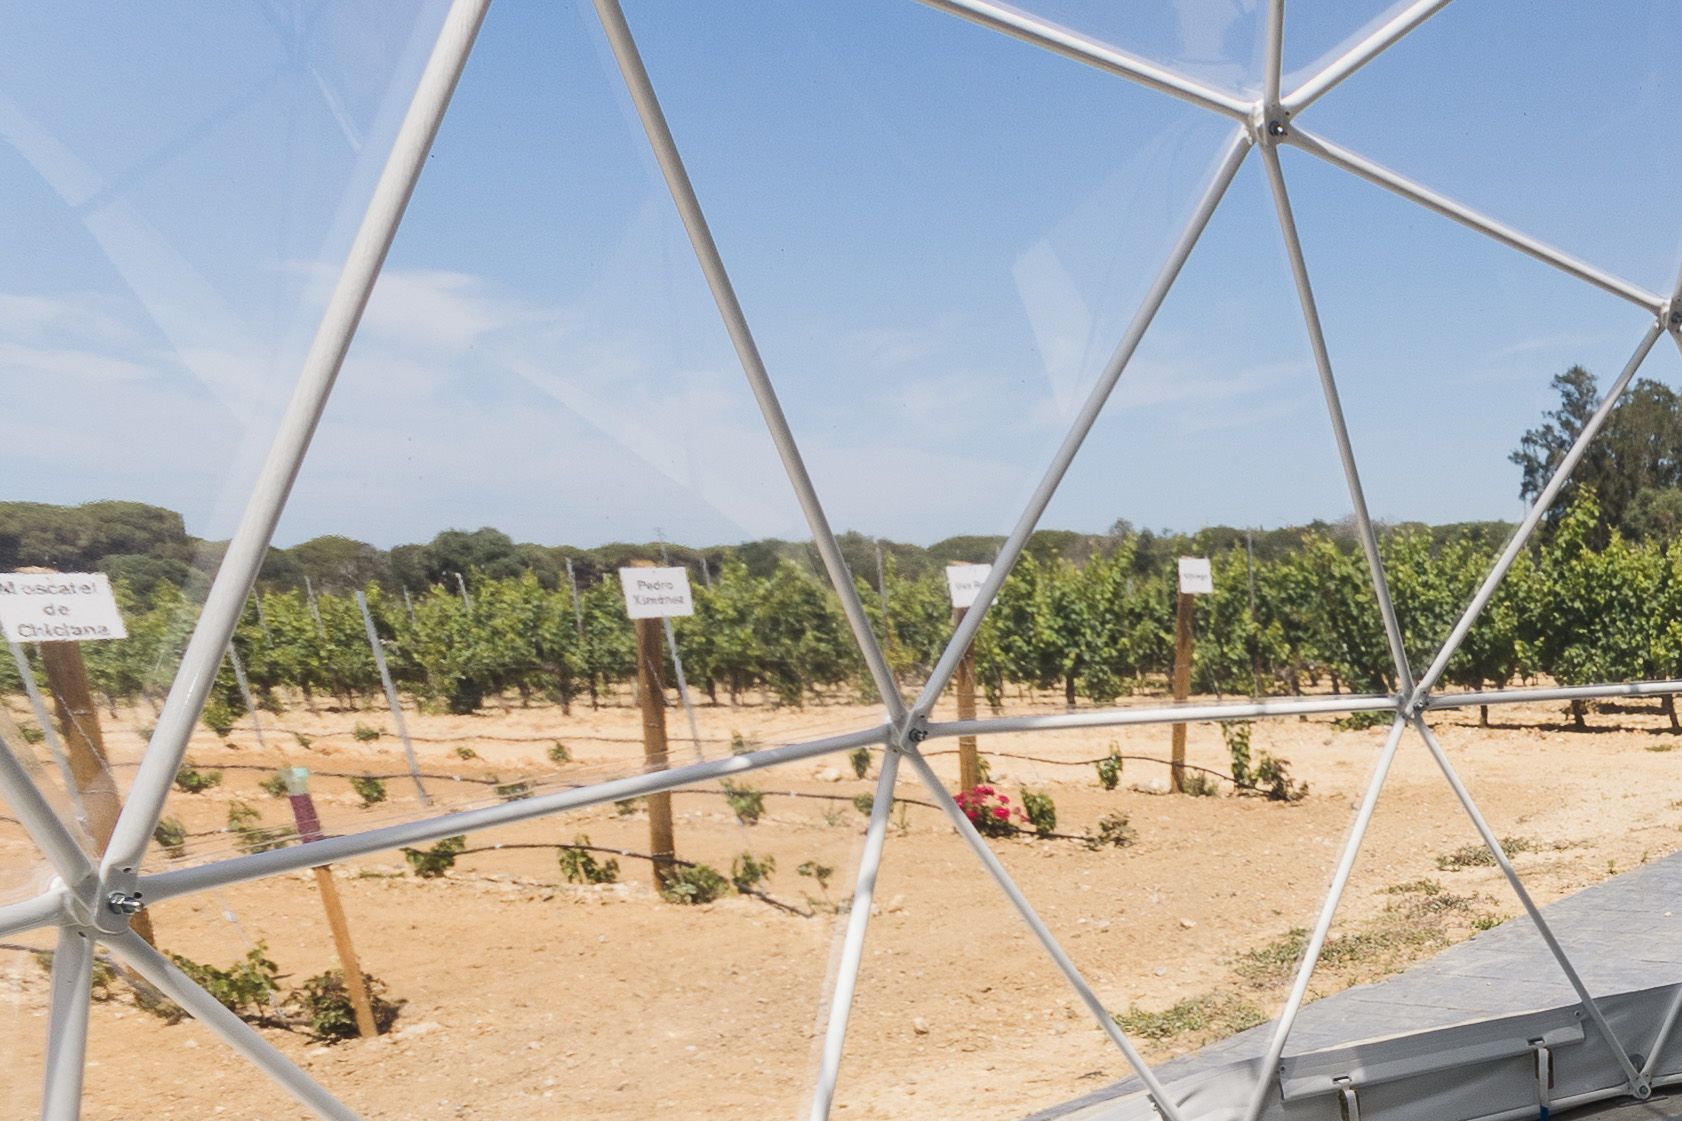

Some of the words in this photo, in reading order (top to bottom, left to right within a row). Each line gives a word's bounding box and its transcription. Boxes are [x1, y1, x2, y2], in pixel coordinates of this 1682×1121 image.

[0, 581, 97, 595] Moscatel
[636, 579, 674, 591] Pedro
[43, 603, 70, 616] de
[17, 622, 110, 638] Chiclana
